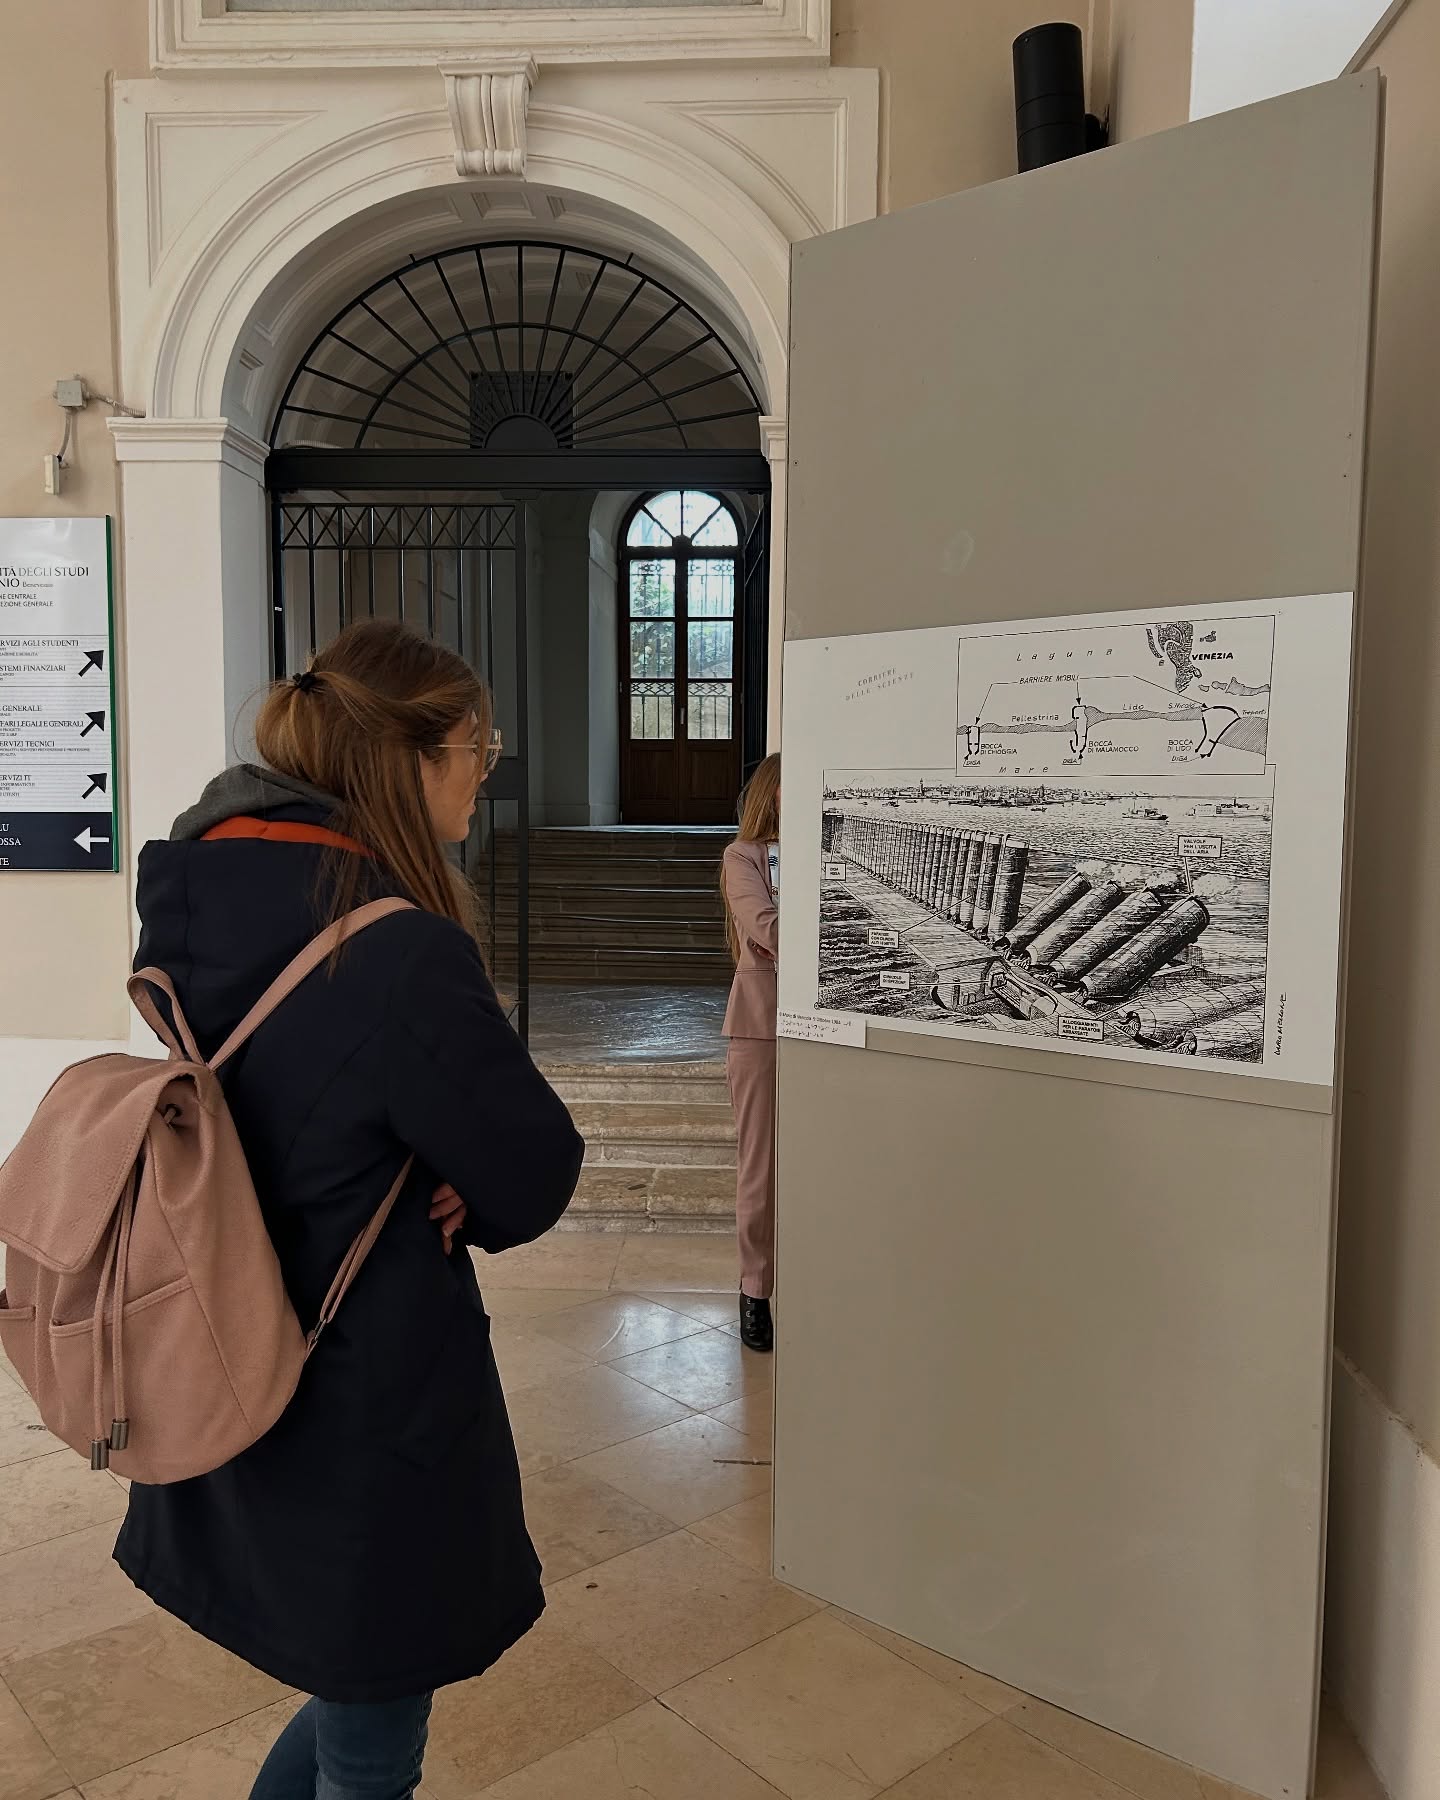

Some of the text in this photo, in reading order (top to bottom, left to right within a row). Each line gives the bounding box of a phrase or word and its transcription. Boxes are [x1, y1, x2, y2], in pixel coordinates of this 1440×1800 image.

[19, 567, 52, 577] DEGLI
[55, 567, 89, 577] STUDI
[1016, 648, 1112, 661] Laguna
[1191, 652, 1234, 660] VENEZIA
[1019, 674, 1079, 685] BARRIERE MOBILI
[1012, 714, 1059, 722] Pellestrina
